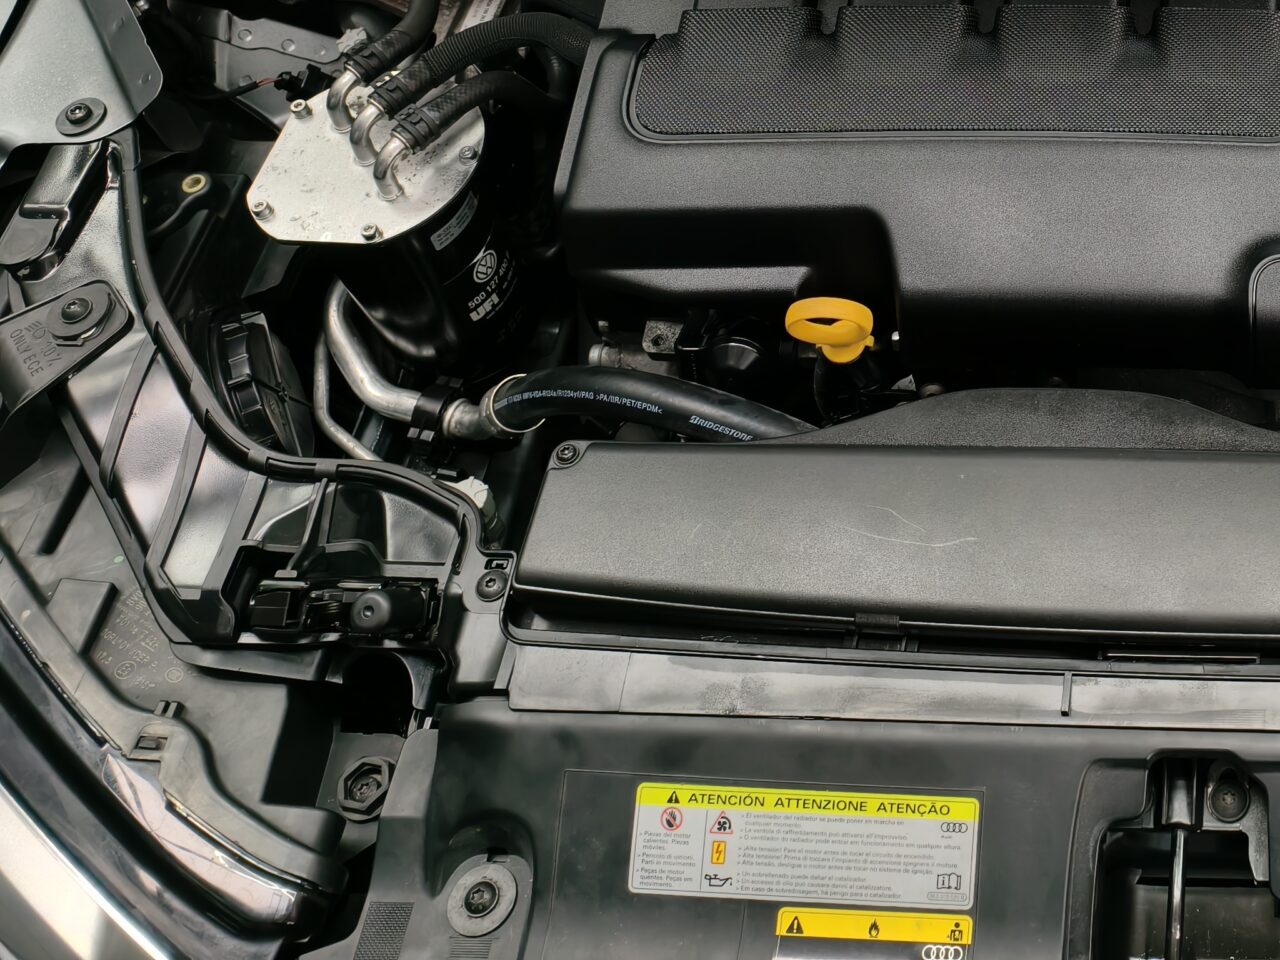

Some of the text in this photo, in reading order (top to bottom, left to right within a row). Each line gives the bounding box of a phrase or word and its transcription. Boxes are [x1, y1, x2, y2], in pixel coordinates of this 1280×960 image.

[486, 275, 498, 292] 127
[469, 292, 500, 322] UFI
[10, 328, 44, 376] ONLY ECE
[596, 393, 663, 414] >PA/IIR/PET/EPDM<
[689, 415, 754, 441] BRIDGESTONE
[688, 792, 950, 817] ATENCIÓN ATTENZIONE ATENÇÃO
